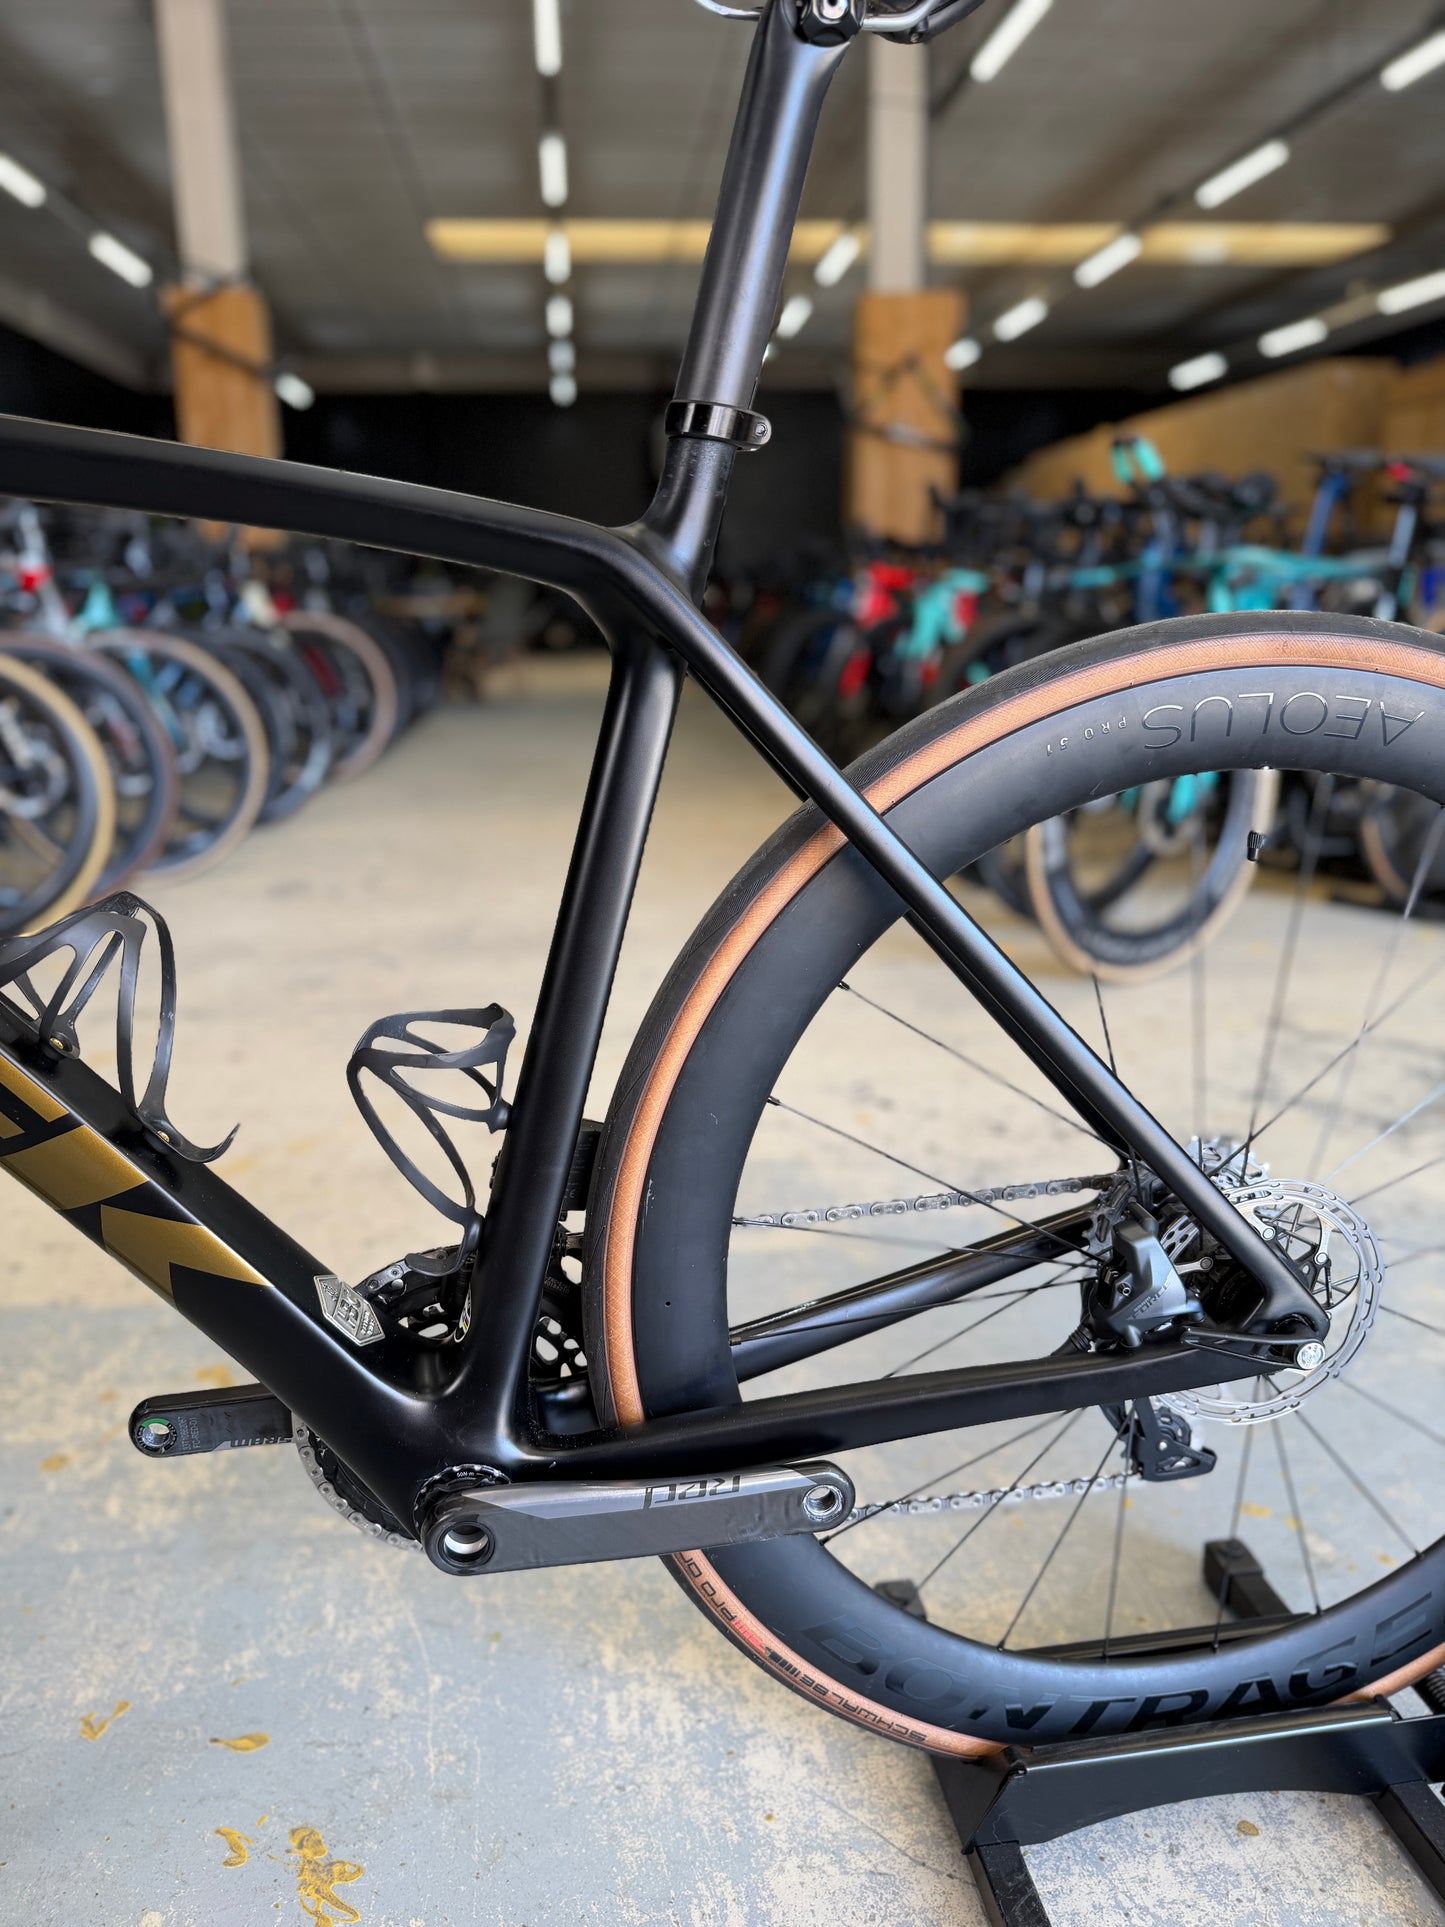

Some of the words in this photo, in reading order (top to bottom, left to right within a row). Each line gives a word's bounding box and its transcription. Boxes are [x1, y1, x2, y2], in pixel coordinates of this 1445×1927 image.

[1084, 716, 1127, 741] PRO
[1141, 691, 1426, 750] AEOLUS
[1046, 736, 1068, 757] 51
[643, 1475, 741, 1509] RED
[801, 1591, 1434, 1735] BONTRAGE
[799, 1674, 927, 1742] SCHWALBE
